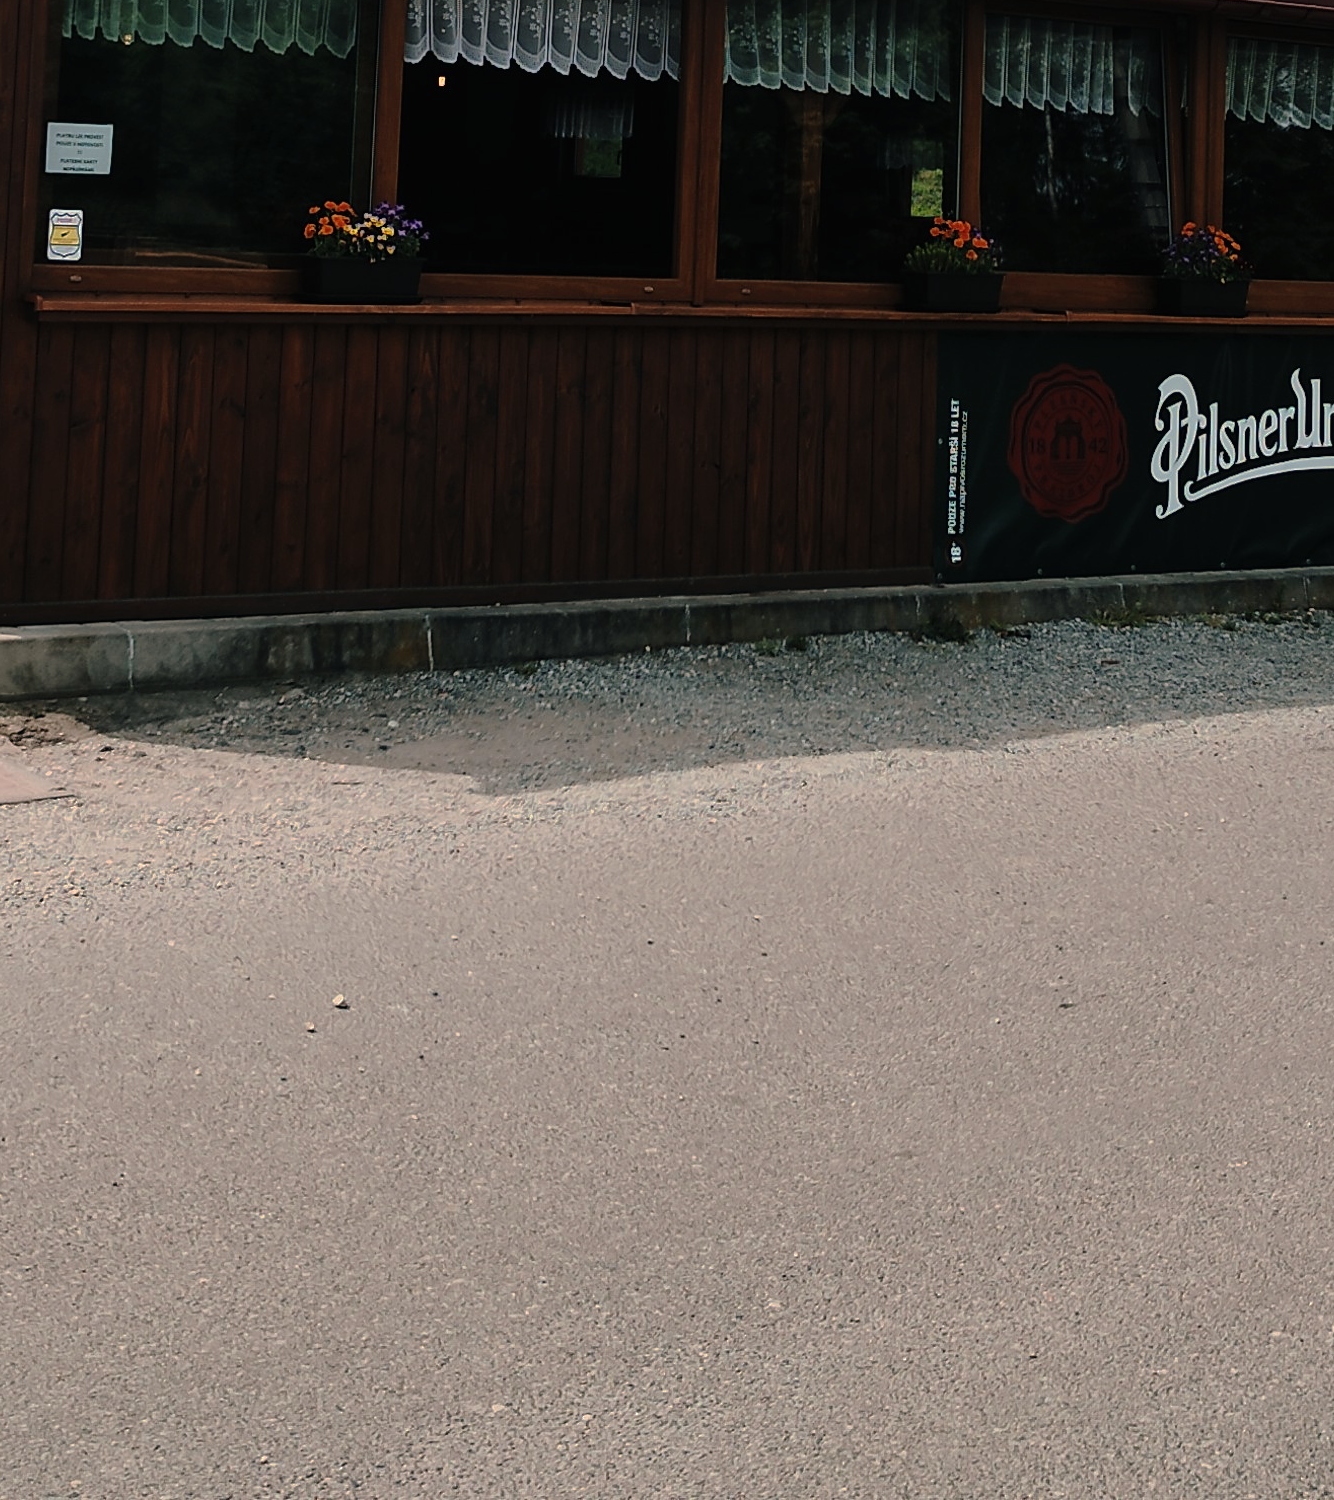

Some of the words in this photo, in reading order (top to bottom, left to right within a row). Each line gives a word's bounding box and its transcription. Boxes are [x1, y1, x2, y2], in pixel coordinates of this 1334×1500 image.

[950, 397, 960, 418] LET
[950, 420, 959, 434] 18
[1088, 436, 1108, 454] 42
[1150, 373, 1296, 519] Pilsner
[948, 476, 957, 498] PRO
[947, 500, 957, 535] POUZE
